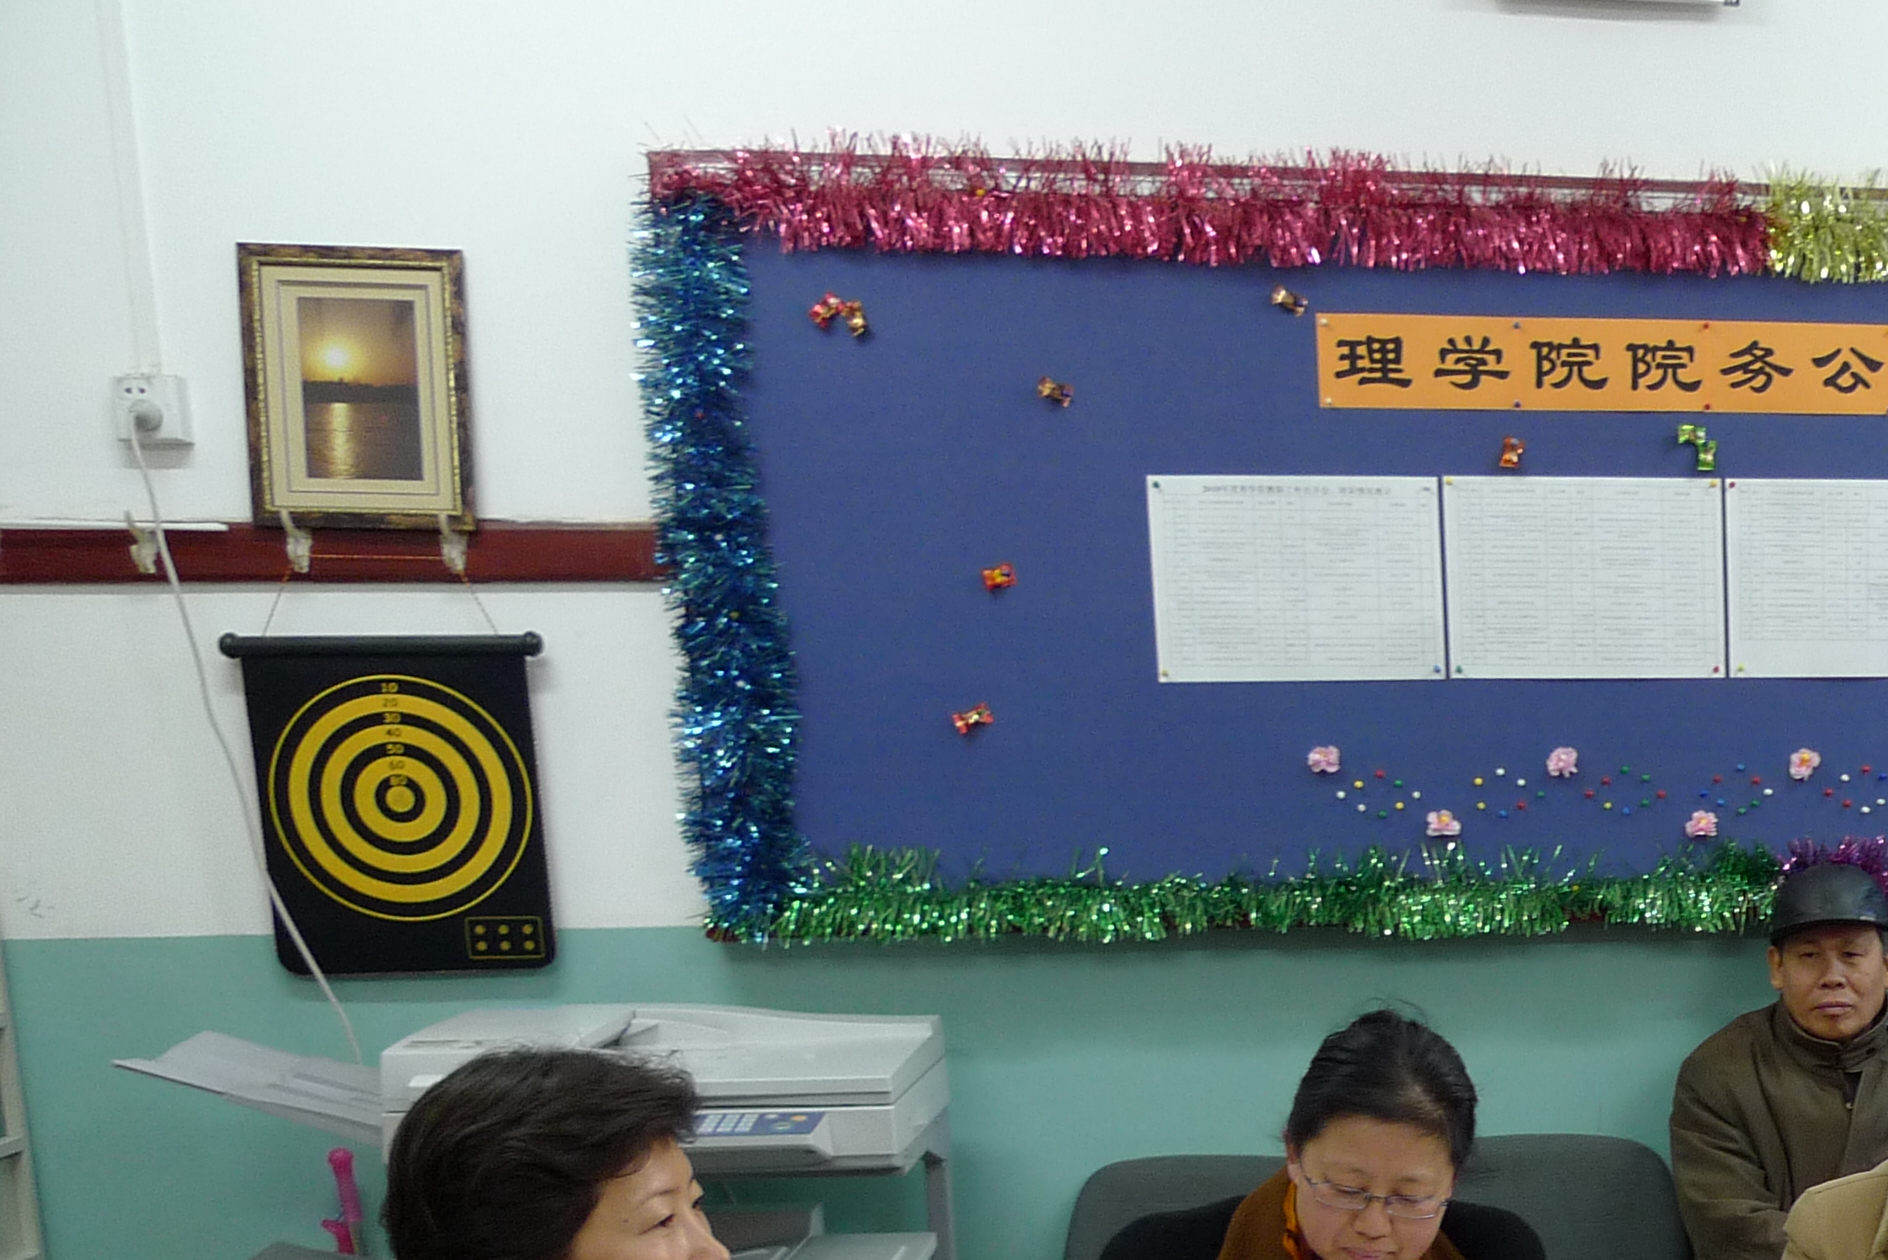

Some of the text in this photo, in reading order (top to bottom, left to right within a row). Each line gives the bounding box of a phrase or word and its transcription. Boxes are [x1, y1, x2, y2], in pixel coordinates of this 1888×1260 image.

[381, 682, 399, 693] 10
[383, 712, 402, 723] 30
[385, 728, 402, 737] 40
